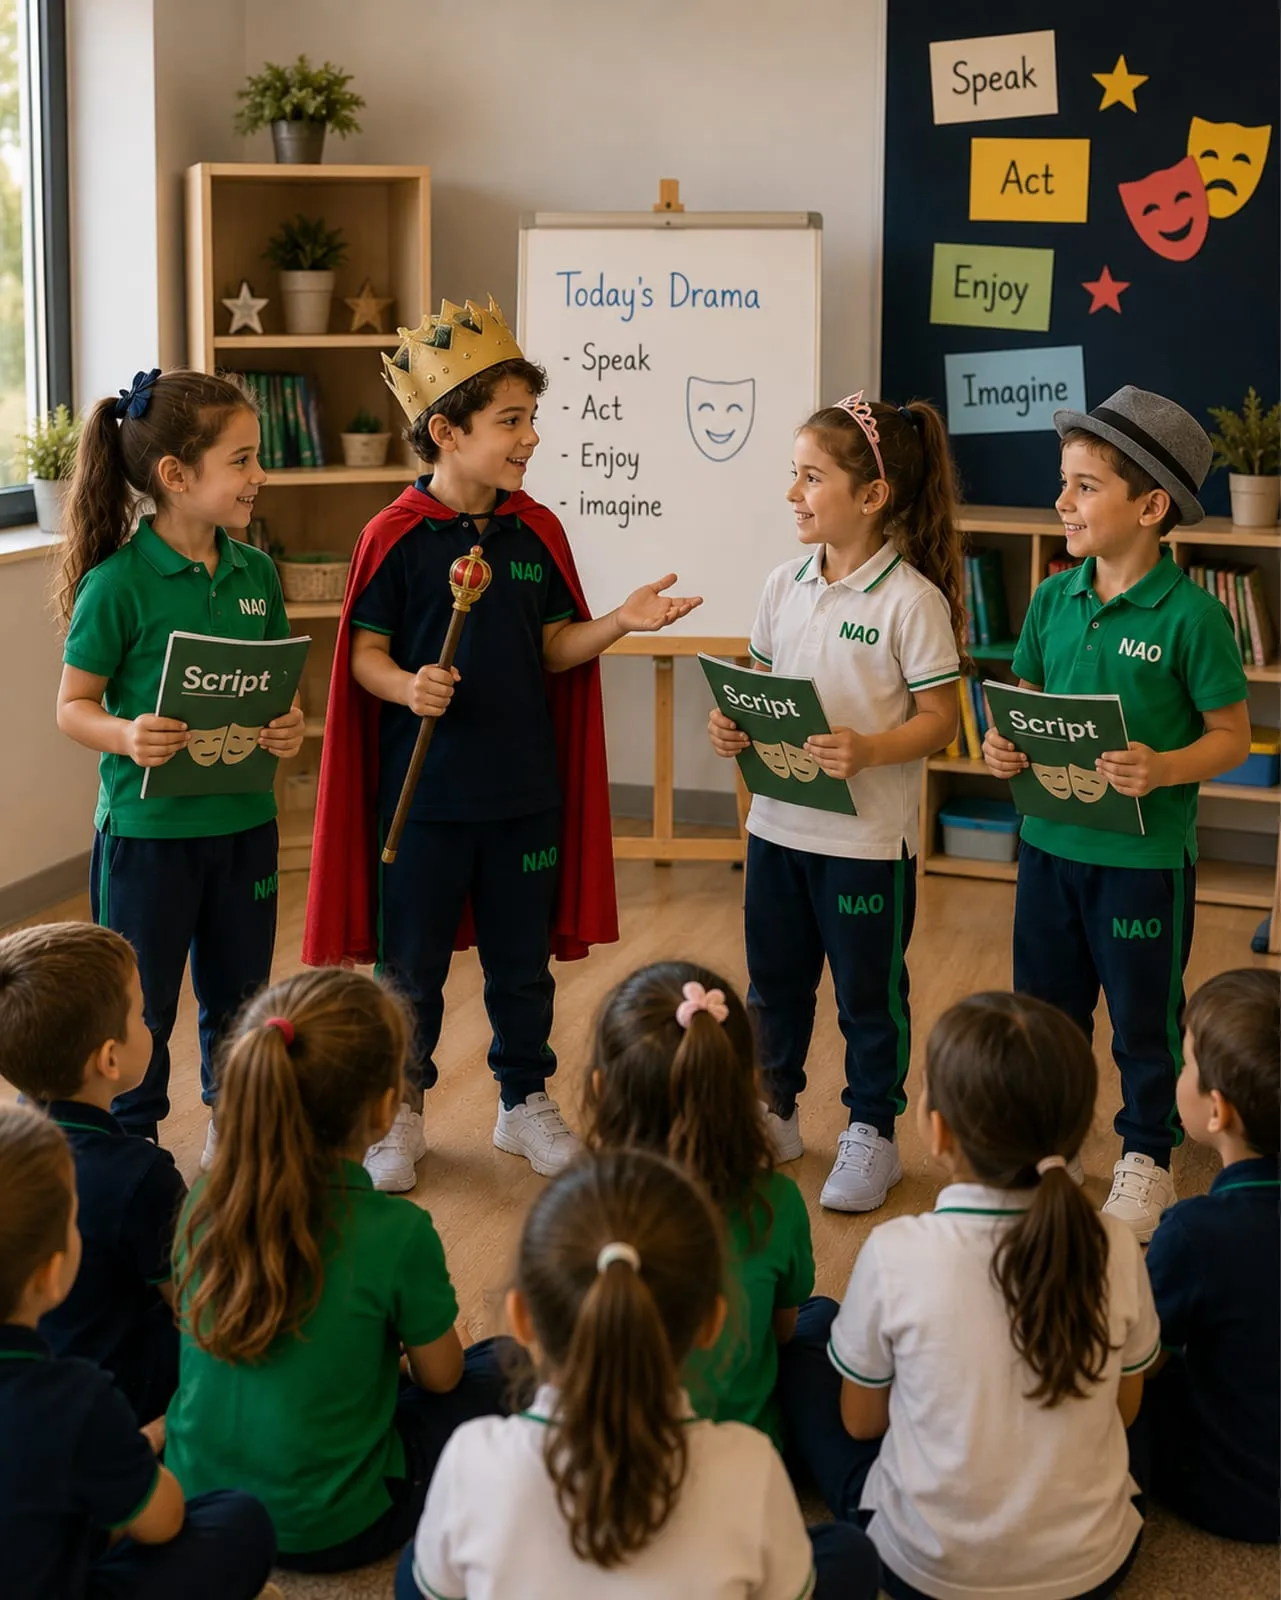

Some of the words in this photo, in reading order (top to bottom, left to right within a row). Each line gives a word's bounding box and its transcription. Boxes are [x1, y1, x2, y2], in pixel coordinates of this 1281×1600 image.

[951, 56, 1037, 106] Speak
[1000, 160, 1055, 195] Act
[556, 271, 654, 322] Today's
[669, 271, 761, 309] Drama
[953, 264, 1029, 315] Enjoy
[581, 342, 651, 381] Speak
[581, 395, 623, 421] Act
[962, 373, 1068, 416] Imagine
[580, 442, 640, 480] Enjoy
[510, 560, 543, 584] NAO
[238, 598, 266, 617] NAO
[839, 621, 879, 646] NAO
[1118, 637, 1162, 663] NAO
[182, 665, 271, 697] Script
[722, 684, 801, 720] Script
[1008, 709, 1099, 743] Script
[522, 846, 558, 873] NAO
[837, 894, 884, 915] NAO
[1112, 917, 1162, 940] NAO
